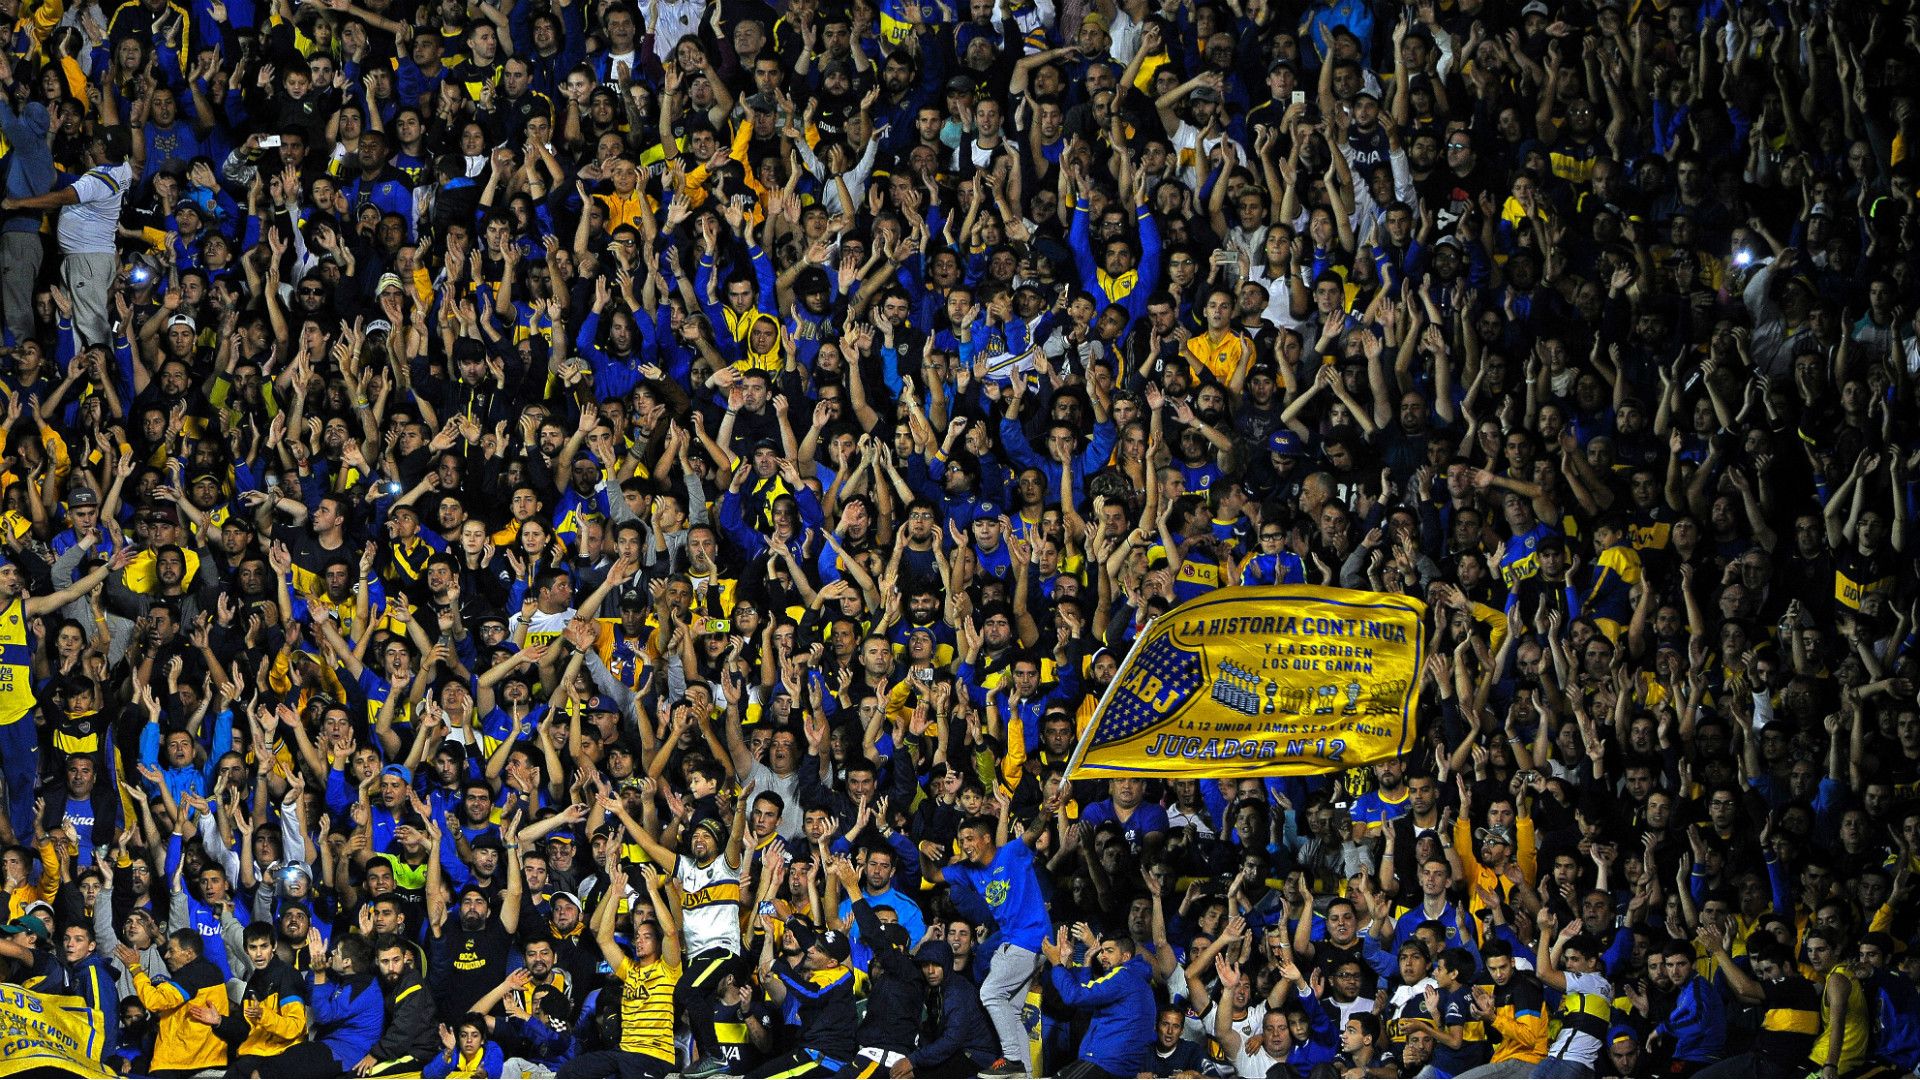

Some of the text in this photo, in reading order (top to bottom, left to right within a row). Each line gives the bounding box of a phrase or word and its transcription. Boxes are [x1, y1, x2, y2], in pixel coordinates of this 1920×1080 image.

[1197, 569, 1210, 579] LG
[1179, 616, 1408, 644] LA HISTORIA CONTINUA
[1264, 643, 1373, 659] Y LA ESCRIBEN
[1262, 659, 1373, 674] LOS QUE GANAN
[1178, 720, 1392, 738] LA 12 UNIDA JAMAS SERA VENCIDA
[1146, 734, 1278, 759] JUGADOR
